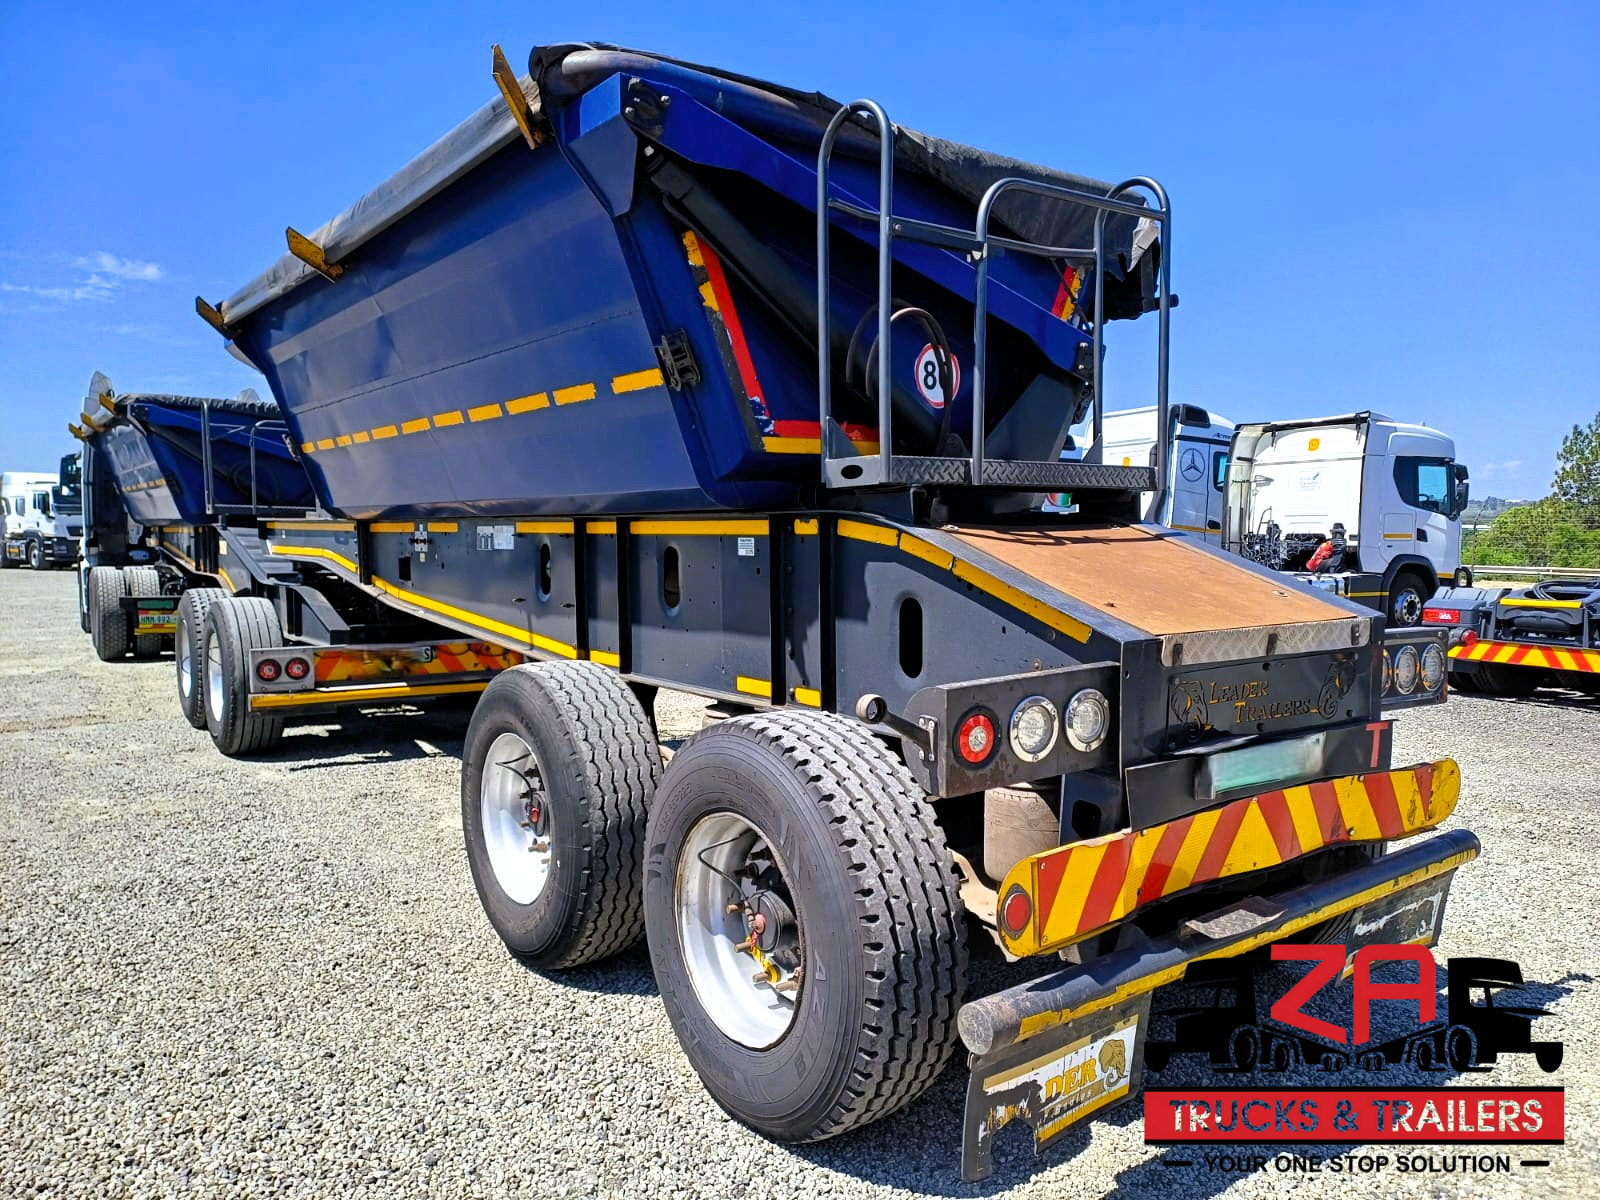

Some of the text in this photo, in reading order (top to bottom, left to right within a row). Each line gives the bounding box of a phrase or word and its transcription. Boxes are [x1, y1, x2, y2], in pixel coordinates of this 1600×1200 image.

[1208, 681, 1270, 704] LEADER
[1234, 698, 1312, 723] TRAILERS
[1366, 722, 1389, 768] T
